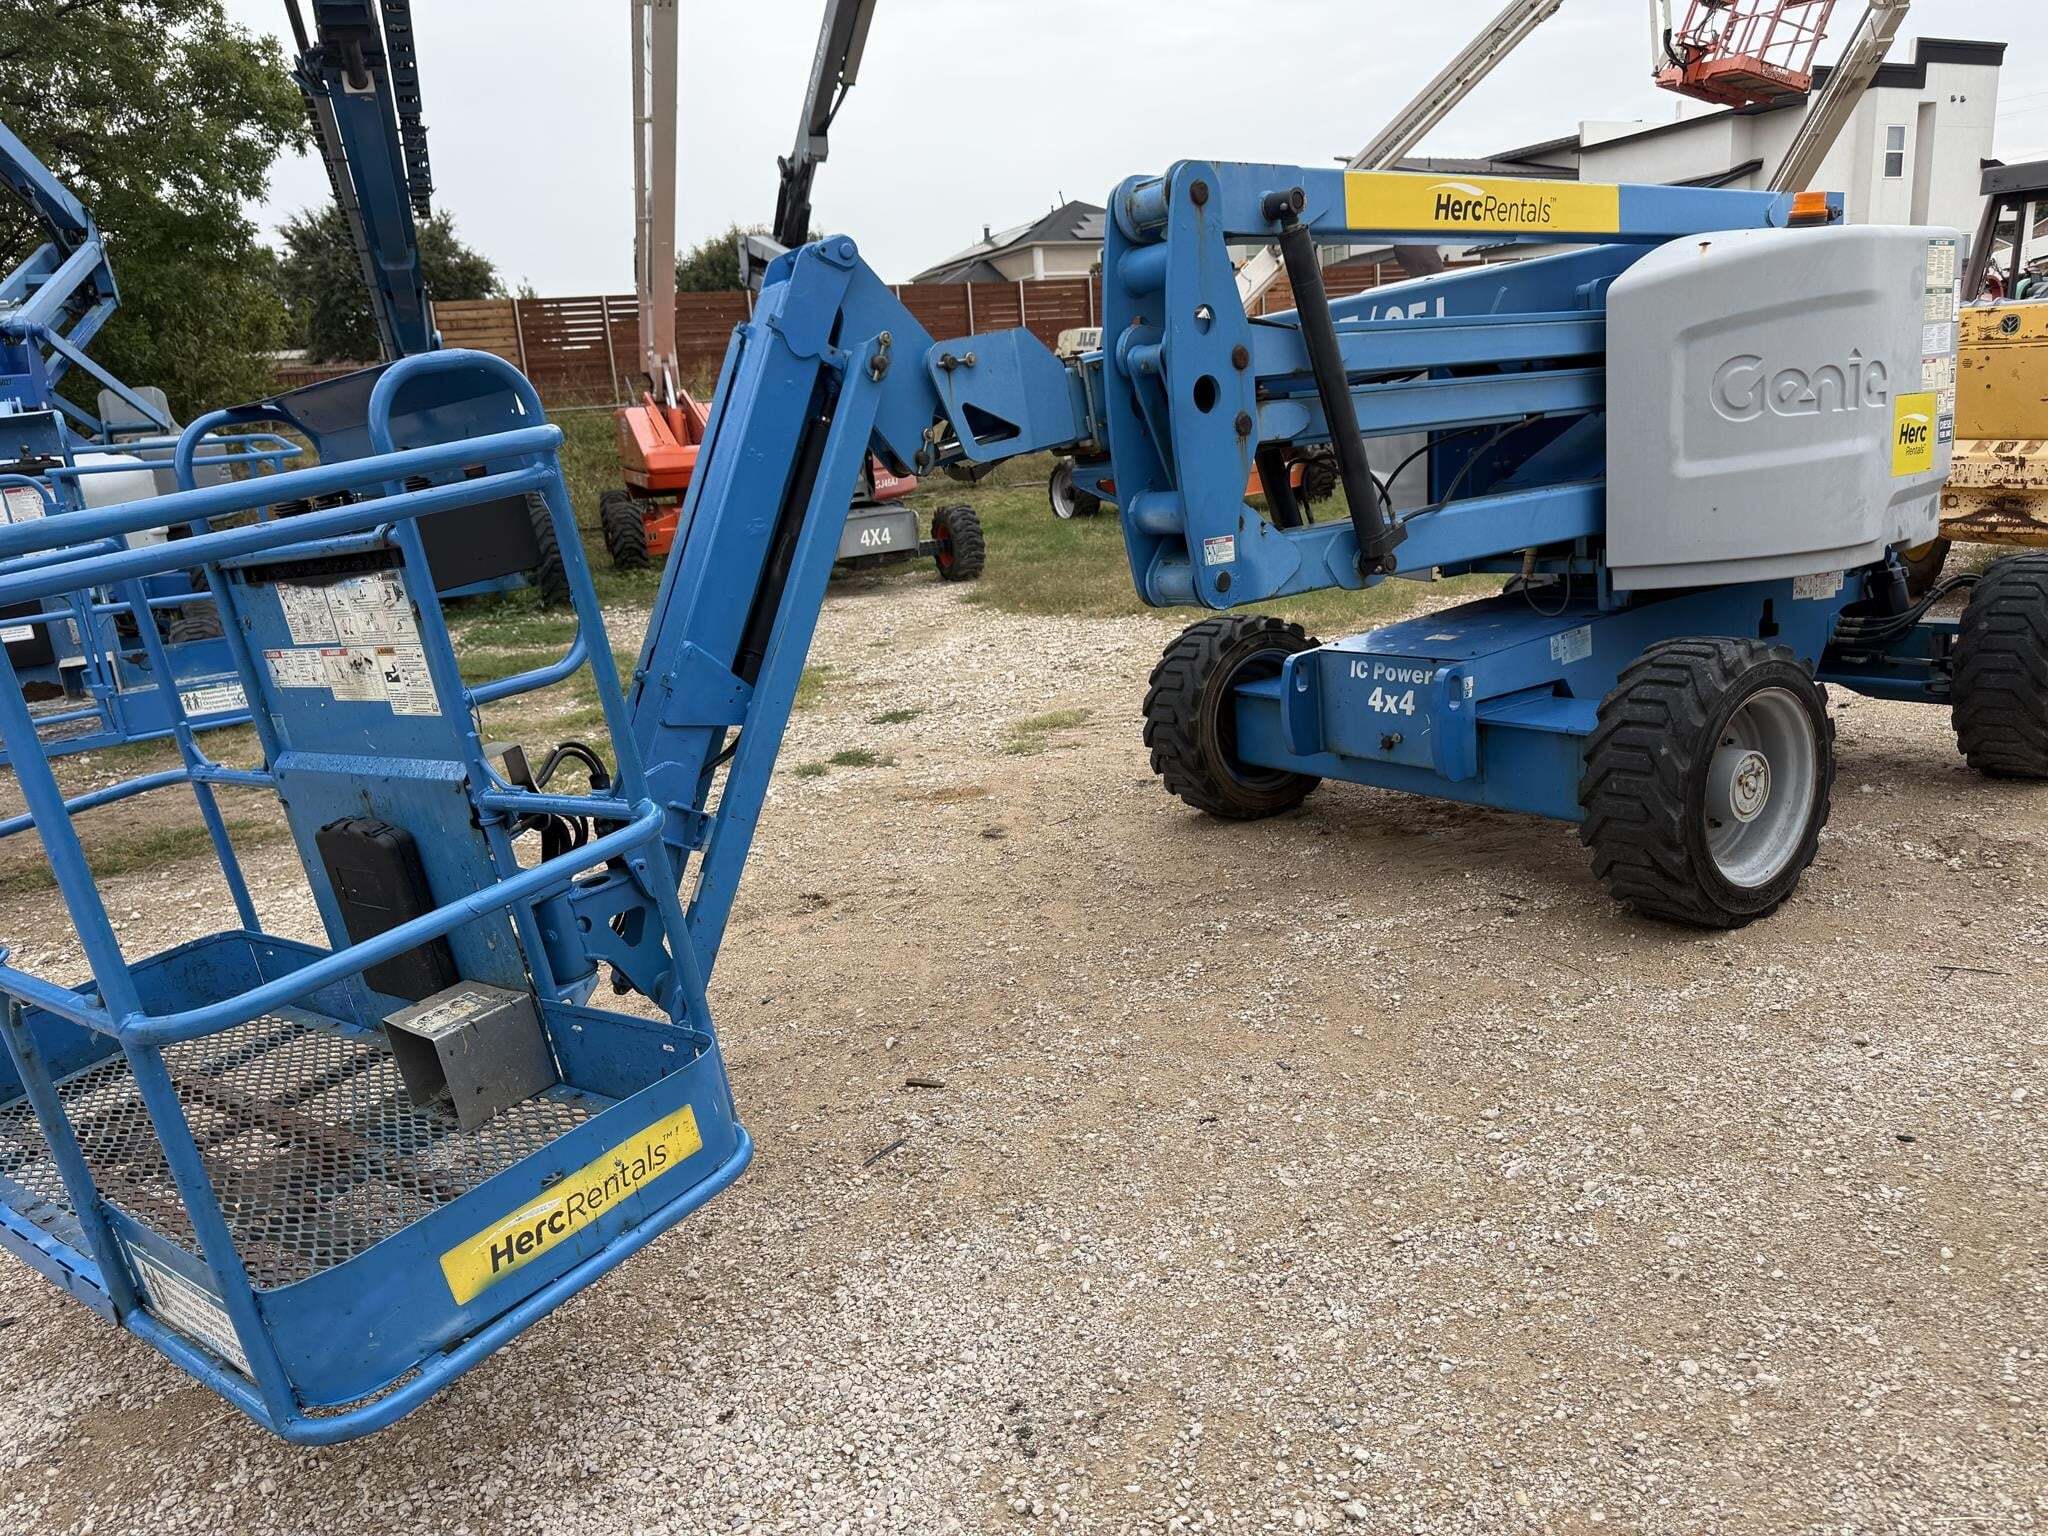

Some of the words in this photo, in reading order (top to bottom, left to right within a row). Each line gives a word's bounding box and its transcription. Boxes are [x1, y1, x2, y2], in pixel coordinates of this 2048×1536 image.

[1077, 331, 1097, 347] JLG
[1709, 348, 1888, 422] Genie
[1898, 422, 1928, 446] Herc
[860, 527, 892, 547] 4X4
[1350, 659, 1368, 679] IC
[1374, 661, 1433, 685] Power
[1367, 686, 1416, 716] 4x4
